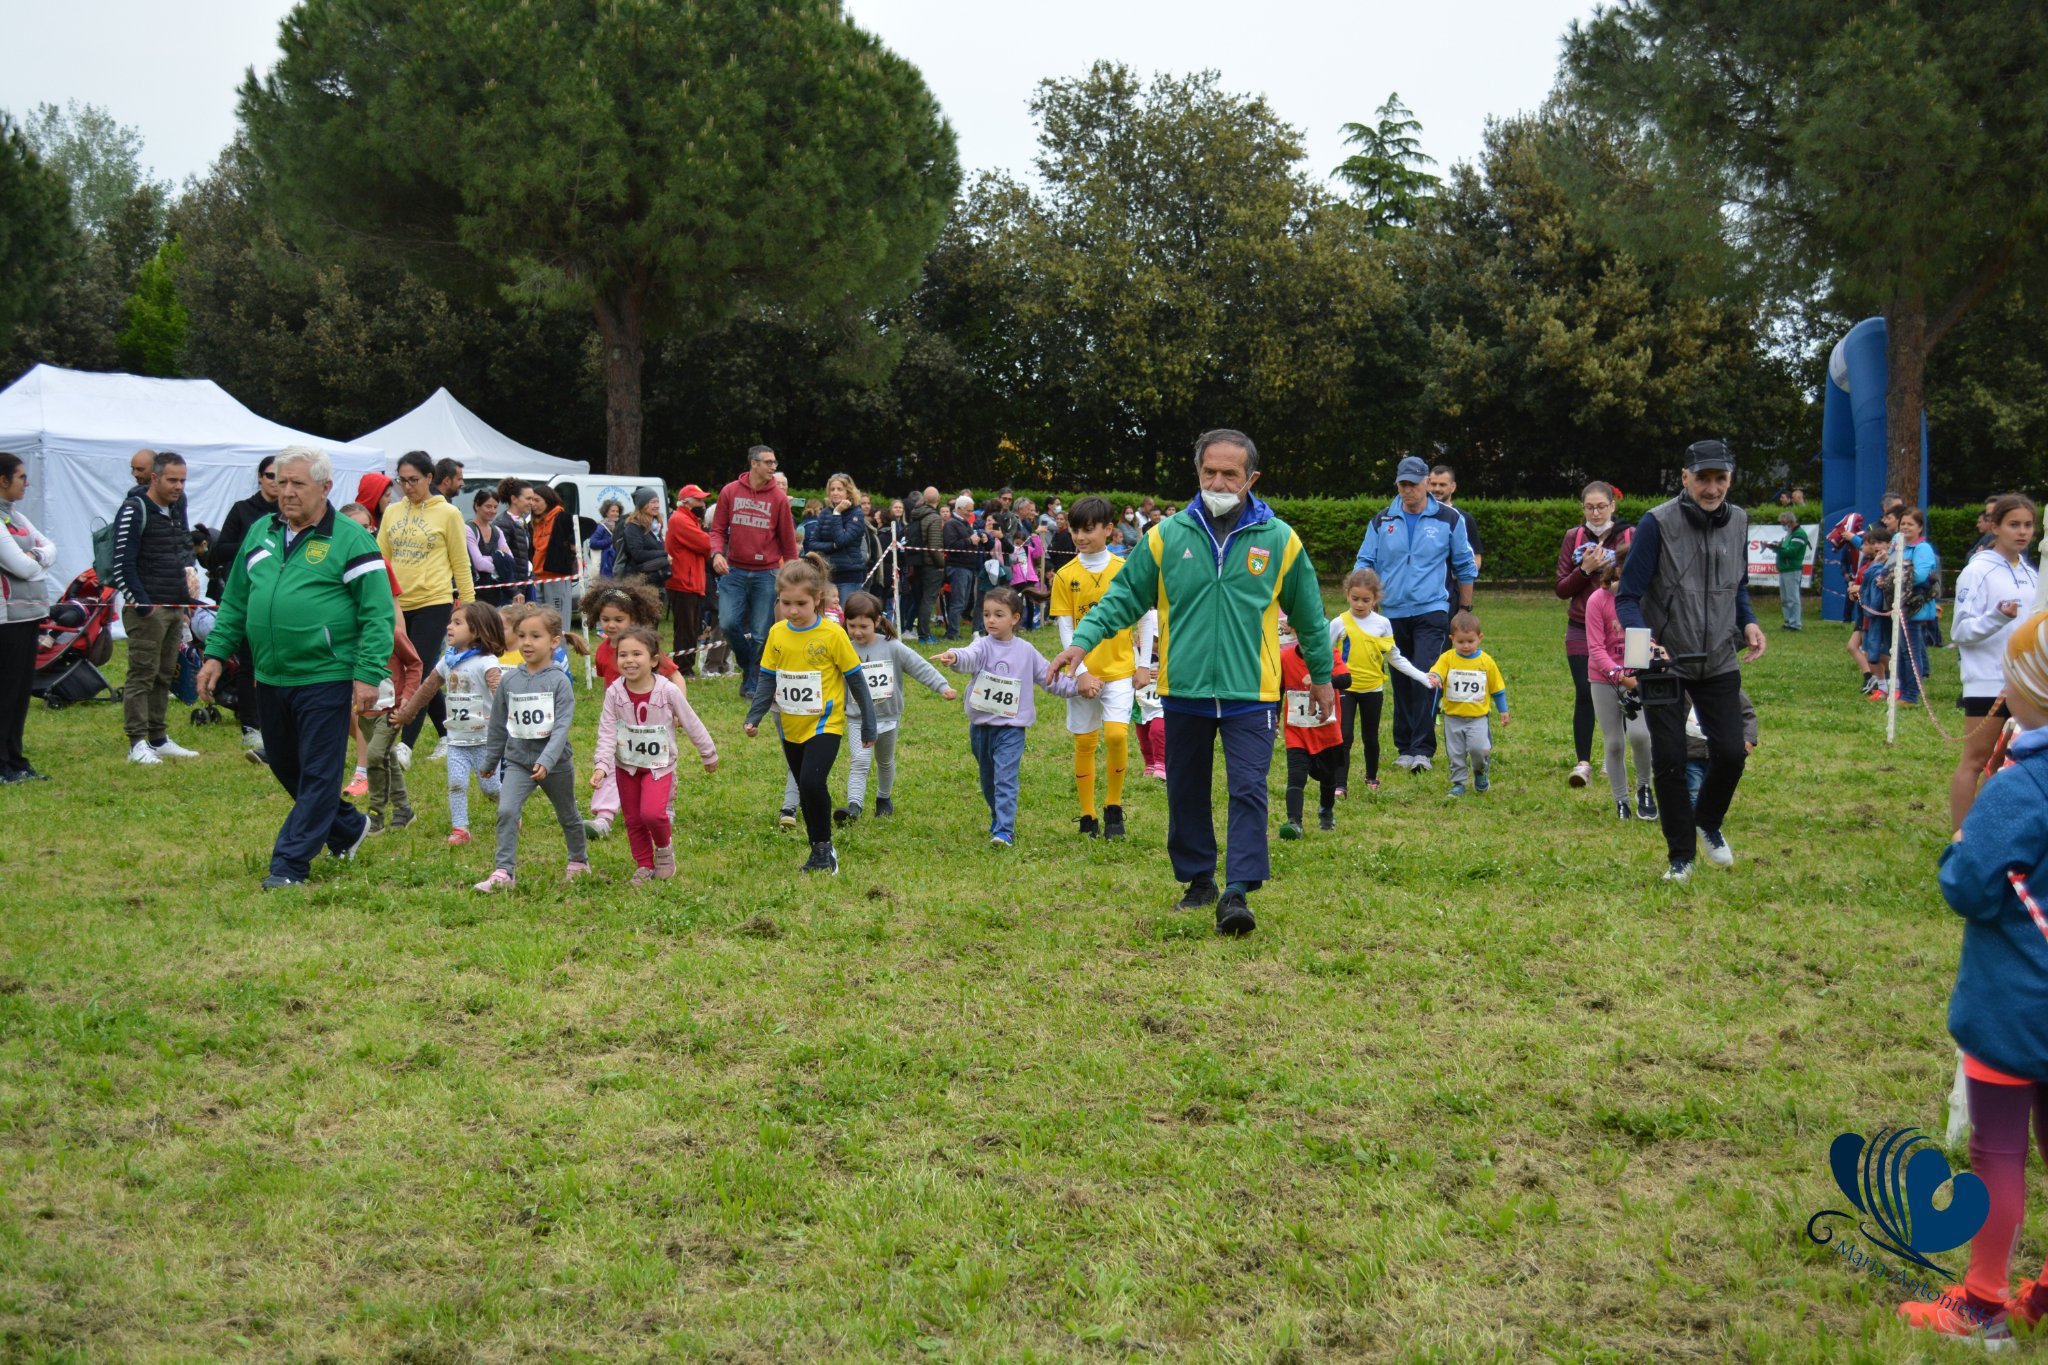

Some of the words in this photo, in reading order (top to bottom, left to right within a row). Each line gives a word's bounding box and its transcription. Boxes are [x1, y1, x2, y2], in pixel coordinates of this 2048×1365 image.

[732, 496, 772, 518] RUSSELL
[412, 515, 437, 542] MELLO
[731, 513, 770, 529] ATHLETIC
[402, 527, 417, 537] NYC
[782, 686, 814, 702] 102
[1453, 681, 1480, 693] 179
[983, 688, 1014, 705] 148
[451, 708, 470, 721] 72
[513, 709, 545, 725] 180
[627, 739, 660, 756] 140
